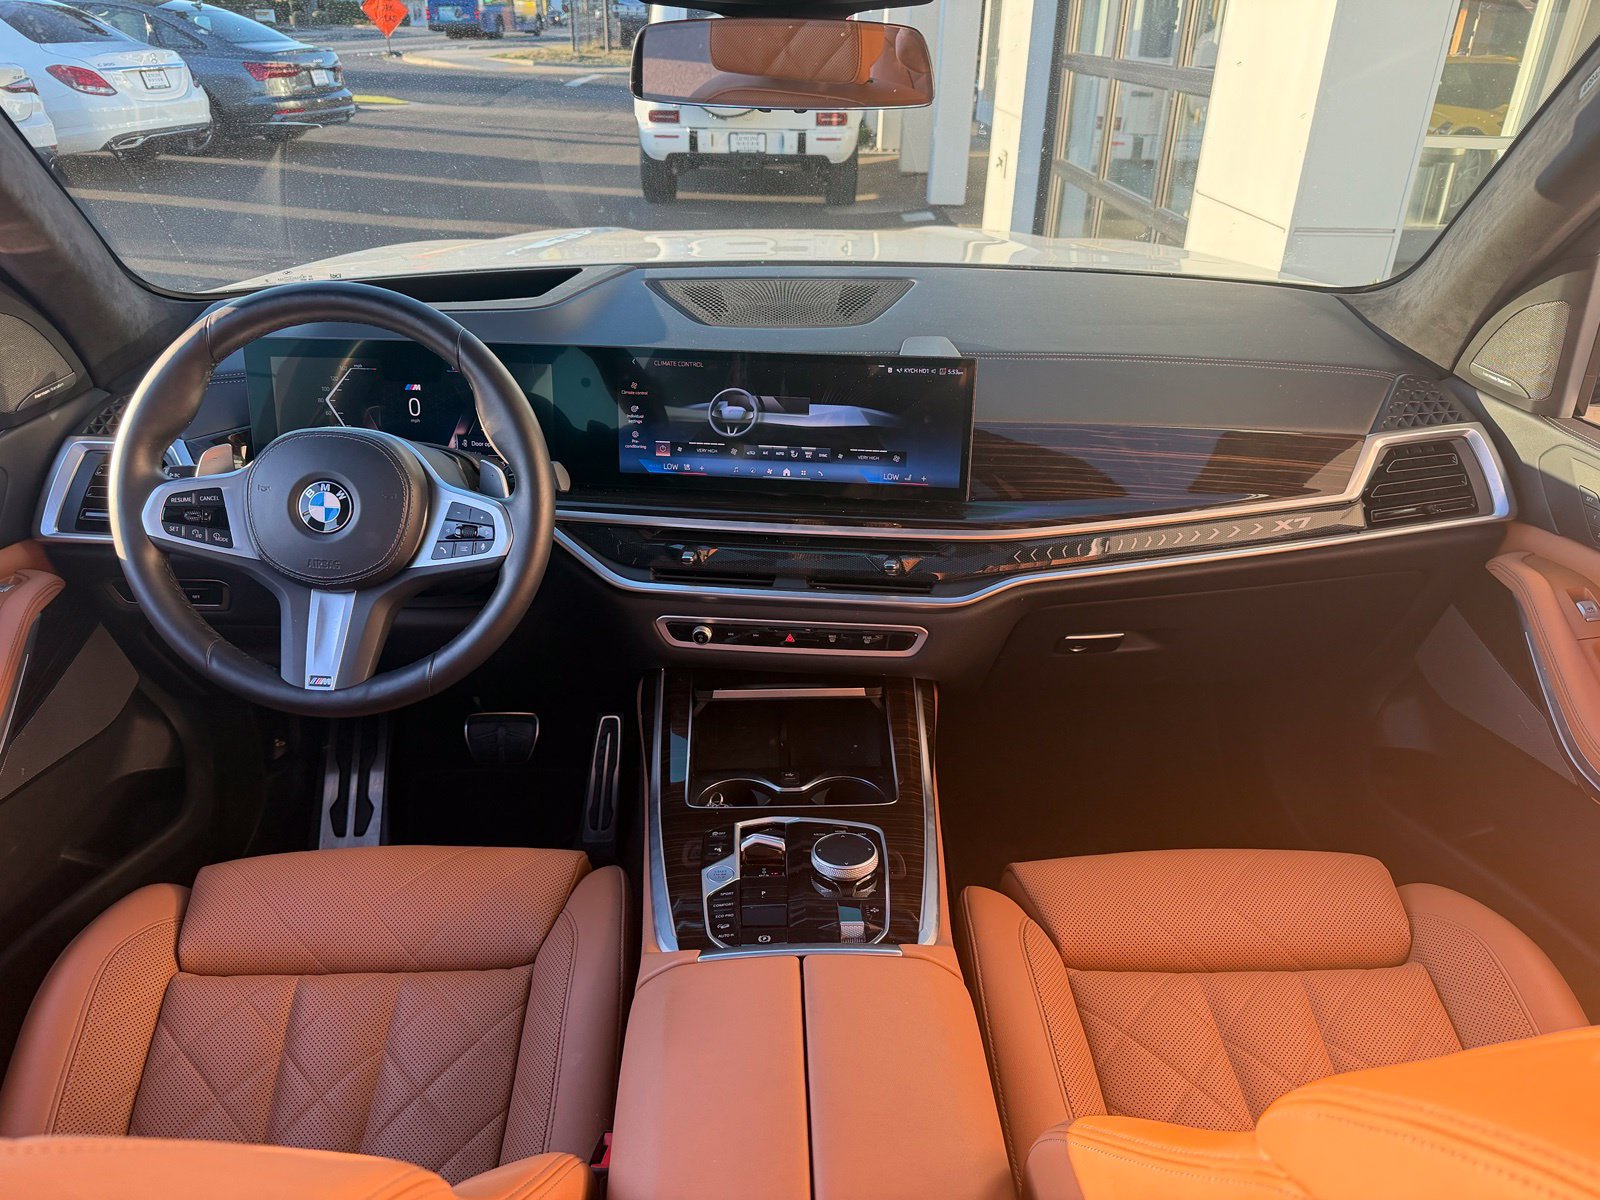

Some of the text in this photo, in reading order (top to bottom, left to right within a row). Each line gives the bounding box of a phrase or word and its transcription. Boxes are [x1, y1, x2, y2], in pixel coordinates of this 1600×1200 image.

[408, 397, 421, 417] 0
[663, 463, 679, 471] LOW
[883, 473, 900, 481] LOW
[305, 483, 347, 500] BMW
[1271, 516, 1312, 532] X7
